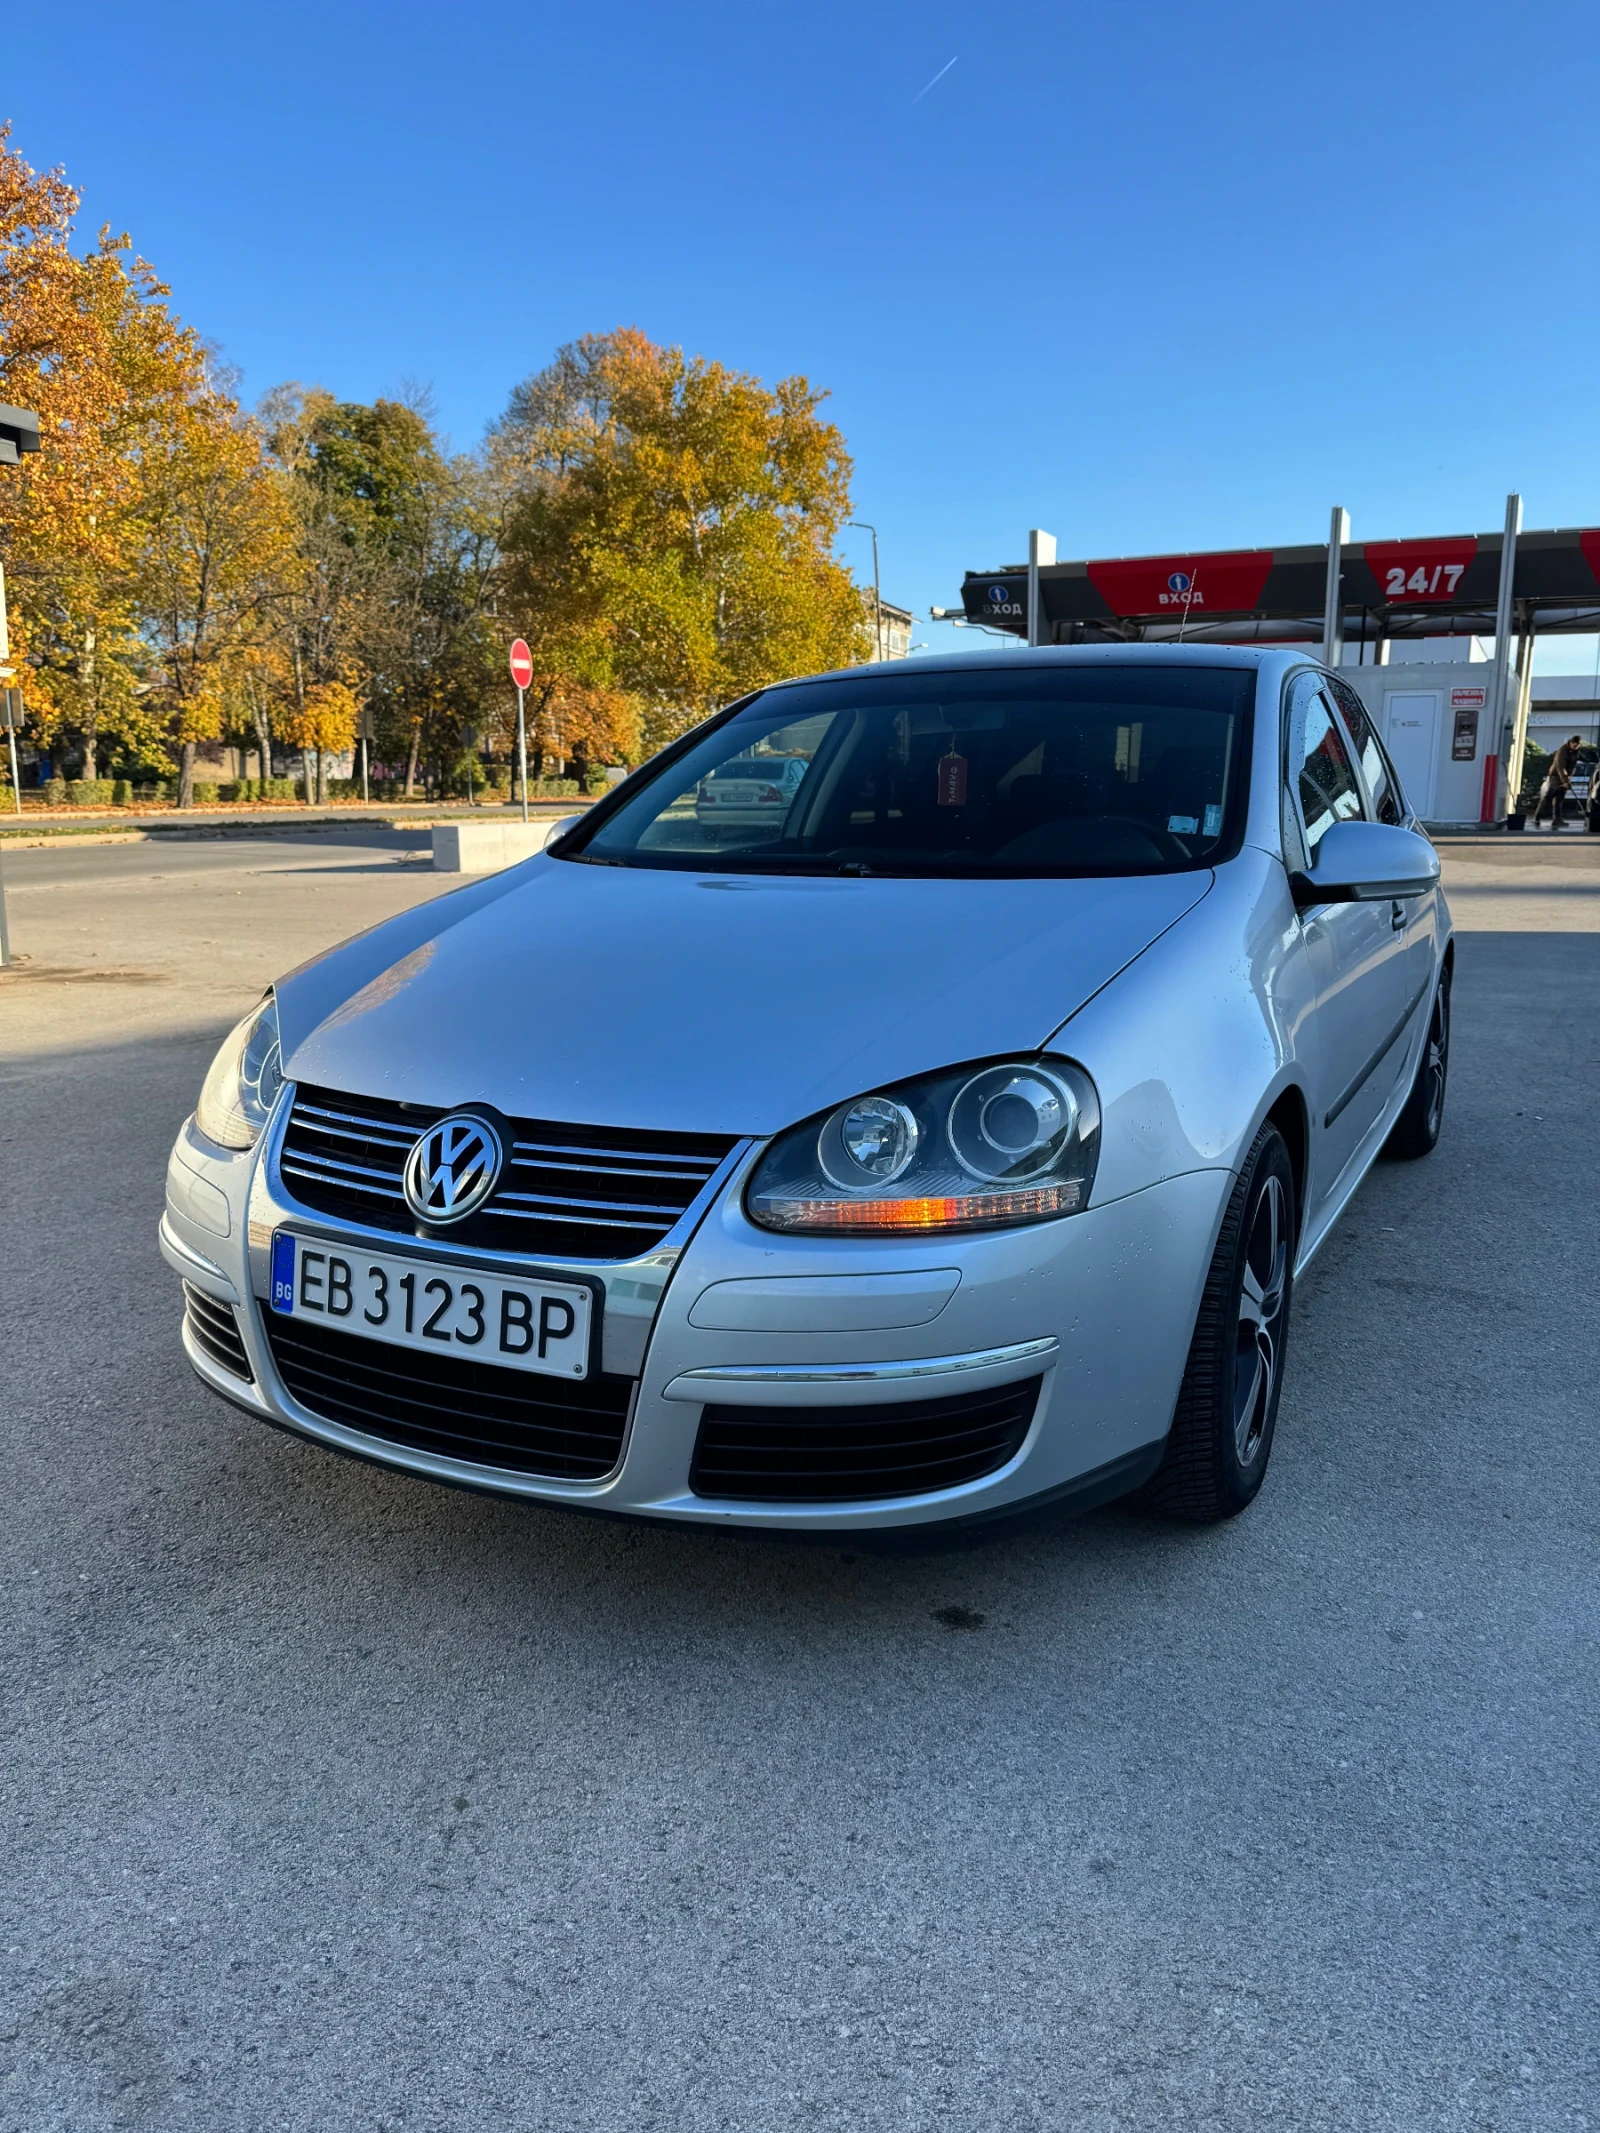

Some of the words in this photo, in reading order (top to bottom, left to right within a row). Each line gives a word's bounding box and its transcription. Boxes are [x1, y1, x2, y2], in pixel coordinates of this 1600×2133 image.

[1385, 564, 1465, 595] 24/7
[1158, 592, 1204, 604] ВХОД
[275, 1281, 293, 1301] BG
[300, 1249, 354, 1316] EB
[364, 1266, 486, 1345] 3123
[499, 1289, 575, 1358] BP
